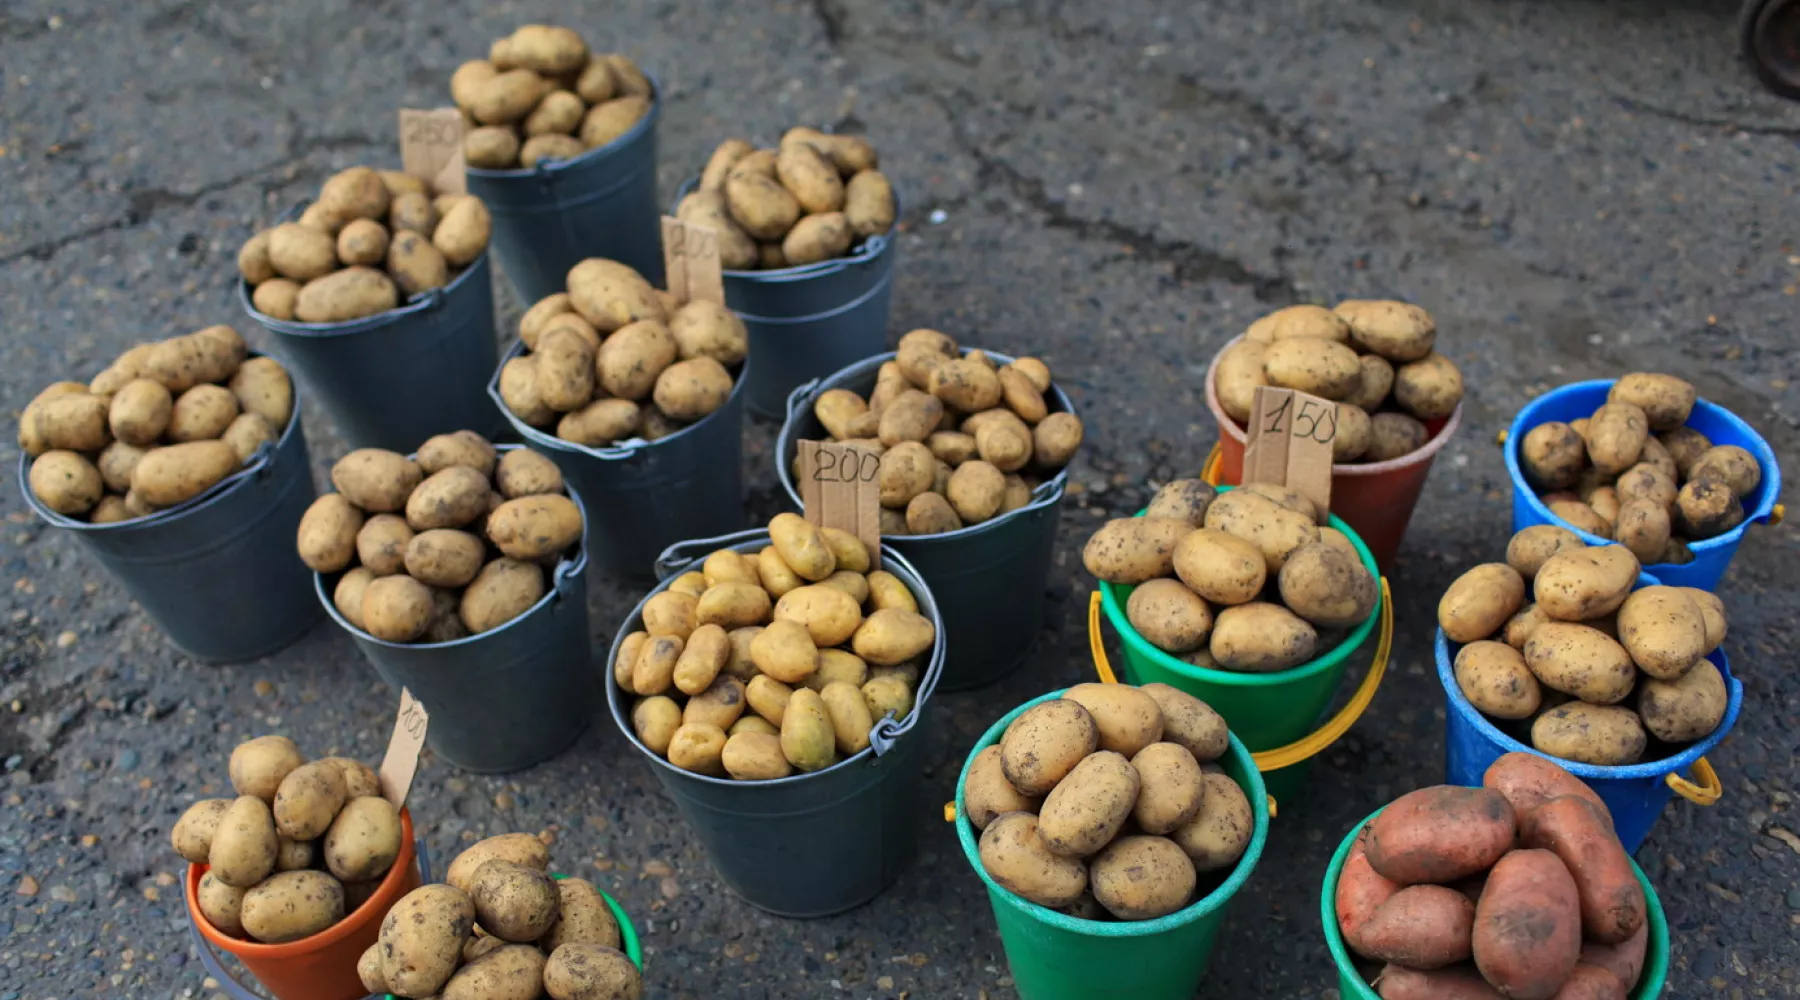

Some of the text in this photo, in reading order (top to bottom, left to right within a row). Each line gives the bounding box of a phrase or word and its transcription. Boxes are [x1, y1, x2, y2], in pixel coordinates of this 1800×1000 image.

[406, 116, 460, 147] 250
[670, 223, 717, 258] 200
[1264, 396, 1336, 443] 150
[813, 447, 880, 482] 200
[402, 704, 425, 740] 100
